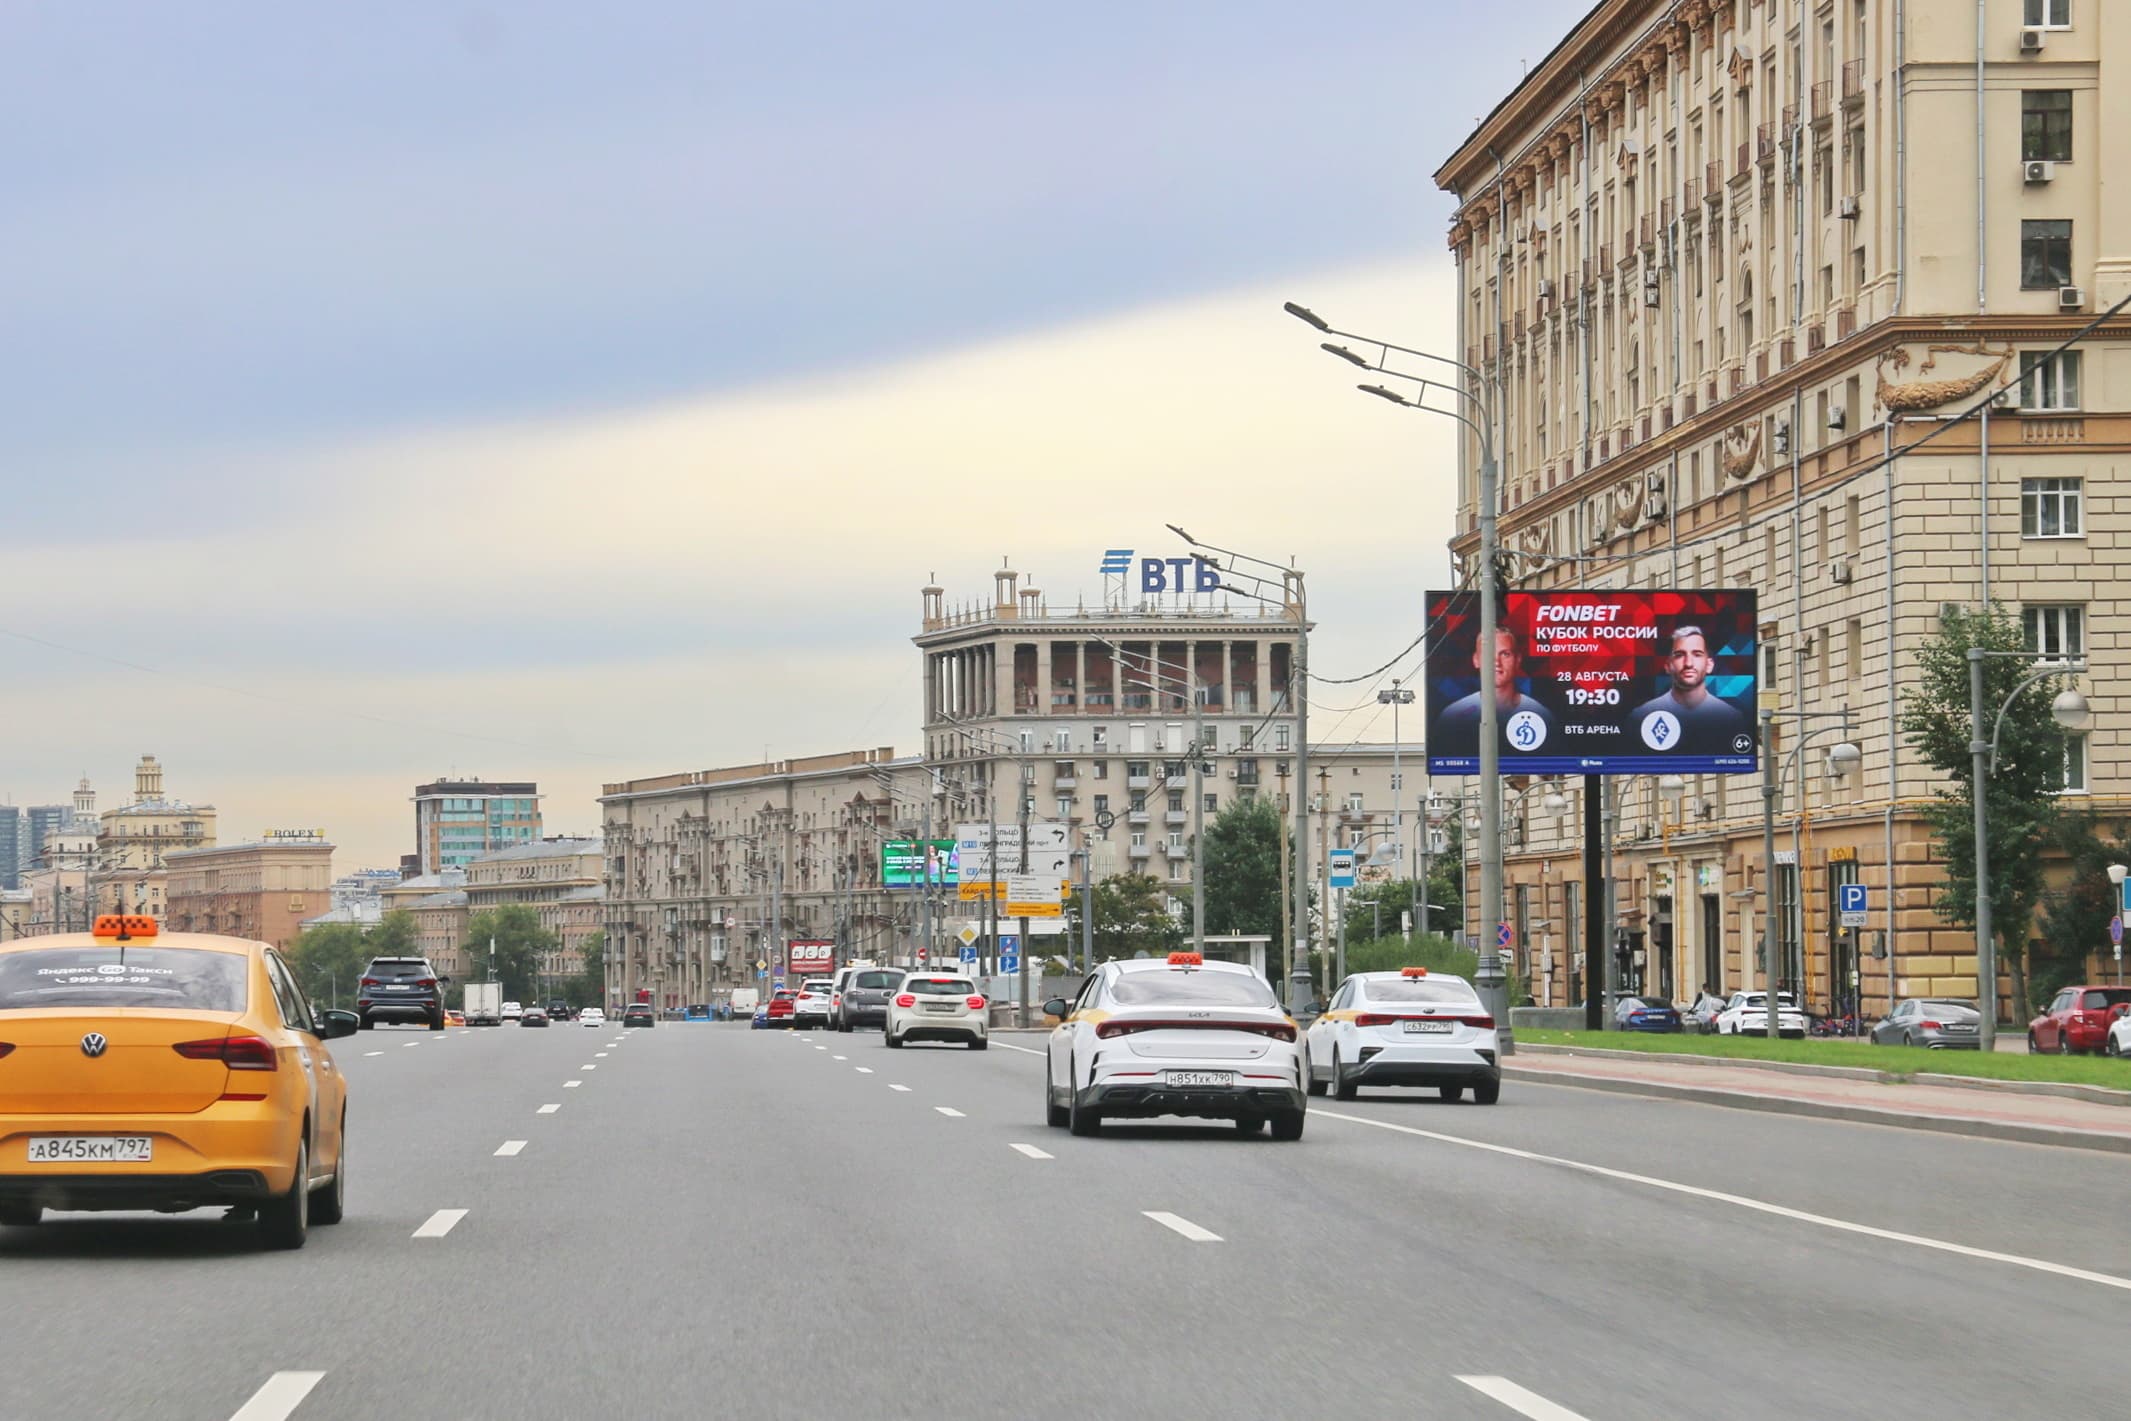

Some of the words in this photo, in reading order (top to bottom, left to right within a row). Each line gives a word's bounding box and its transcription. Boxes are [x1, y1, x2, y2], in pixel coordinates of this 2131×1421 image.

[1141, 558, 1220, 593] ВТБ
[1536, 605, 1621, 621] FONBET
[1536, 627, 1588, 639] КУБОК
[1593, 627, 1658, 639] РОССИИ
[1536, 644, 1550, 652] ПО
[1552, 644, 1598, 652] ФУТБОЛУ
[1557, 671, 1572, 681] 28
[1575, 671, 1630, 681] АВГУСТА
[1565, 688, 1620, 705] 19:30
[1565, 725, 1584, 734] ВТБ
[1586, 725, 1621, 734] АРЕНА
[1735, 738, 1749, 748] 6+
[274, 829, 314, 837] ROLEX
[1848, 888, 1862, 909] P
[37, 967, 95, 975] Яндекс
[128, 966, 173, 975] Такси
